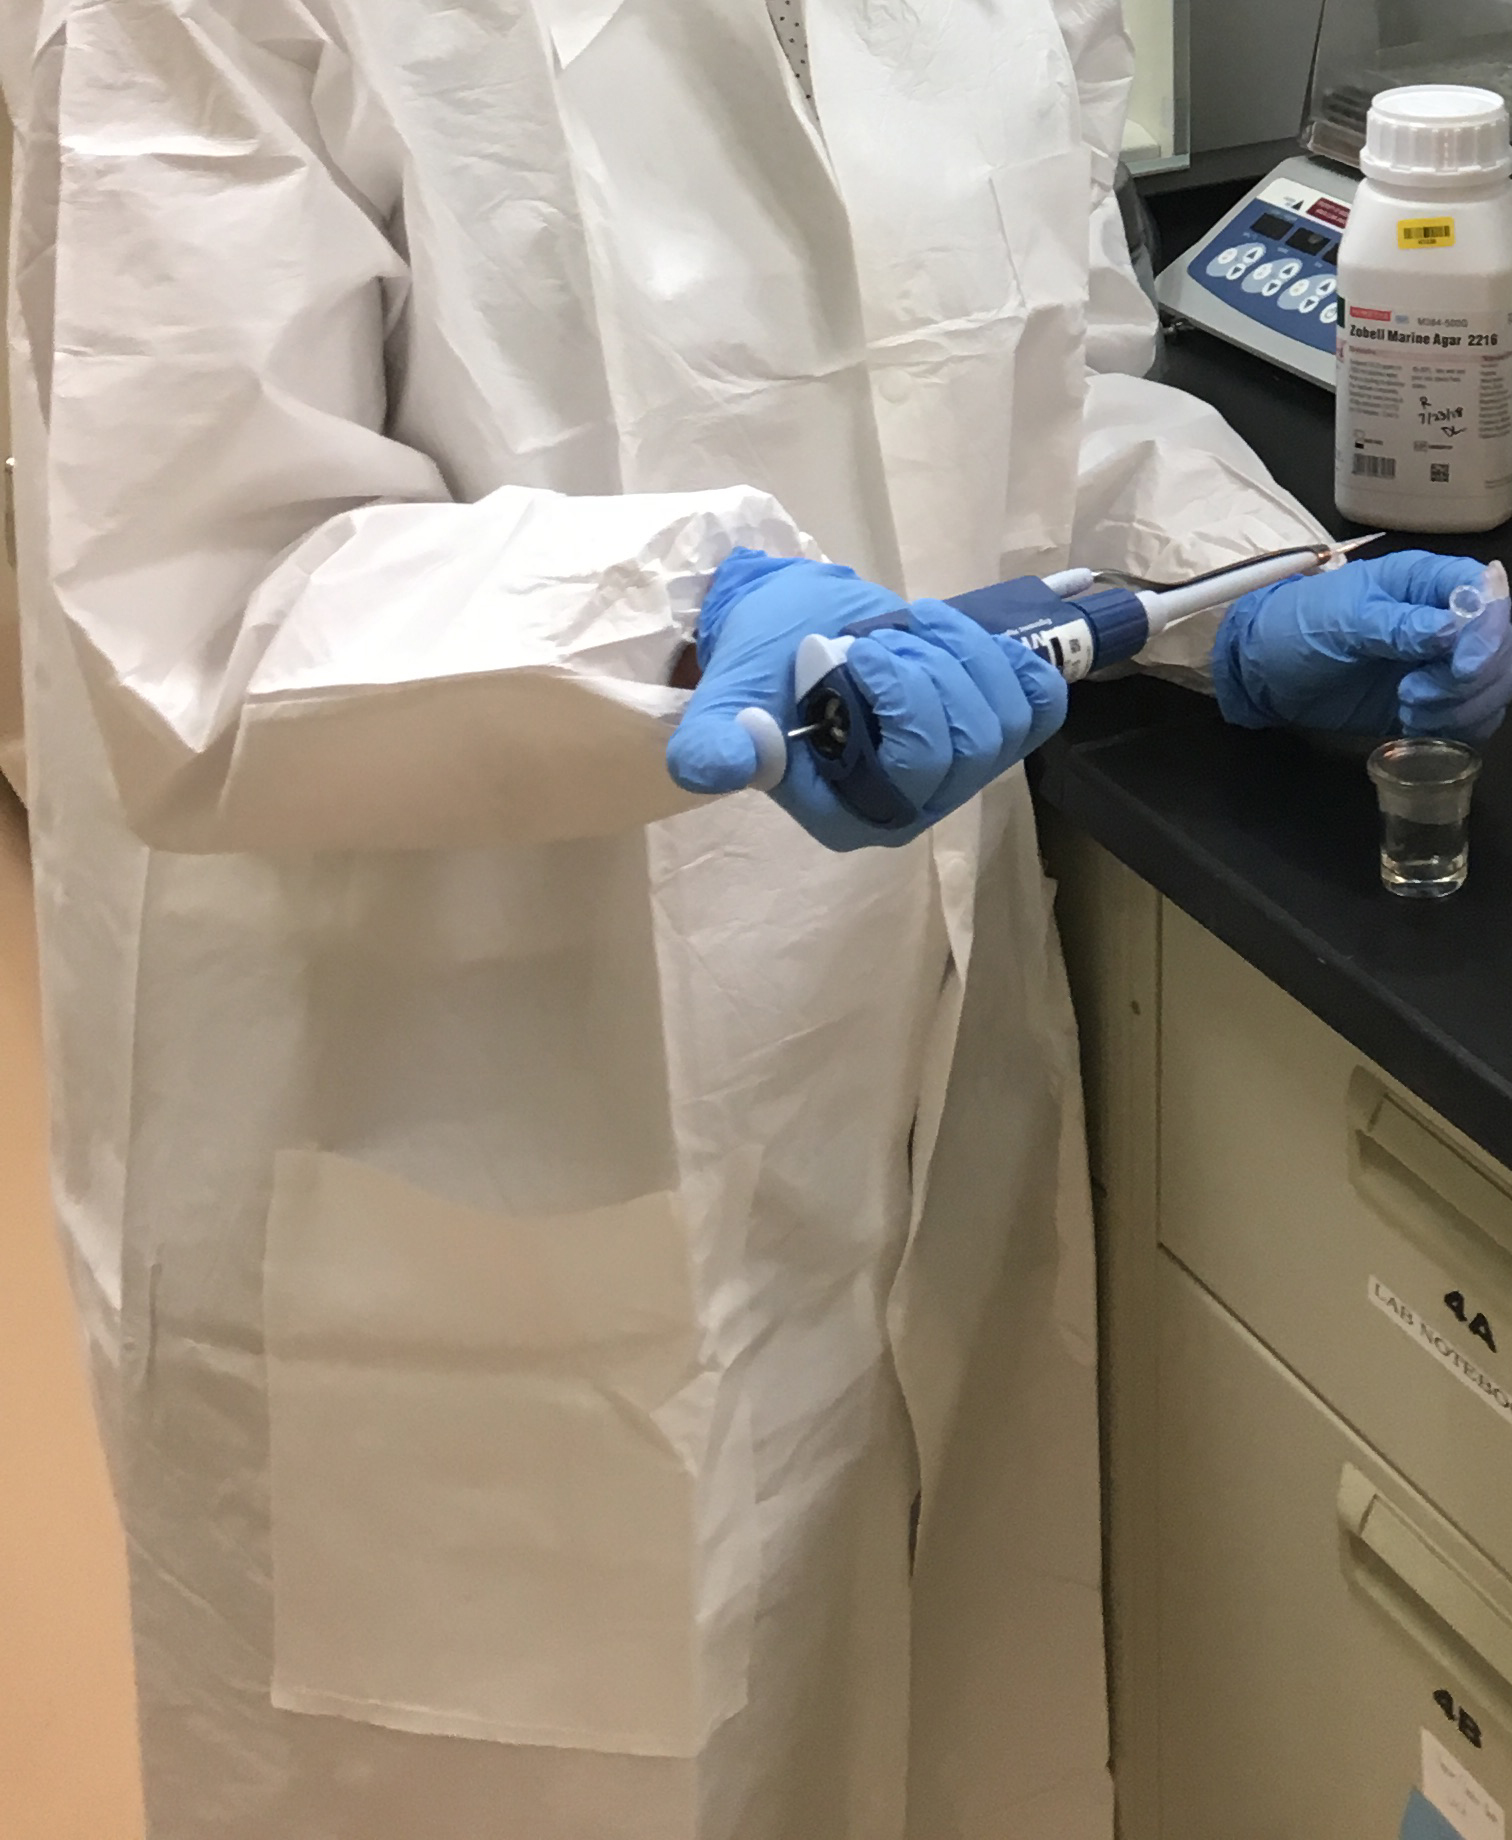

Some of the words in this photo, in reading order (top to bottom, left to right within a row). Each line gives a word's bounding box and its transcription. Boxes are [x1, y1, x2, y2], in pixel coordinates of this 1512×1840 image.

[1350, 323, 1385, 341] Zobell
[1387, 332, 1430, 345] Marine
[1433, 333, 1461, 348] Agar
[1468, 333, 1498, 347] 2216
[1375, 1282, 1415, 1326] LAB
[1444, 1290, 1498, 1354] 4A
[1432, 1687, 1483, 1749] 4B
